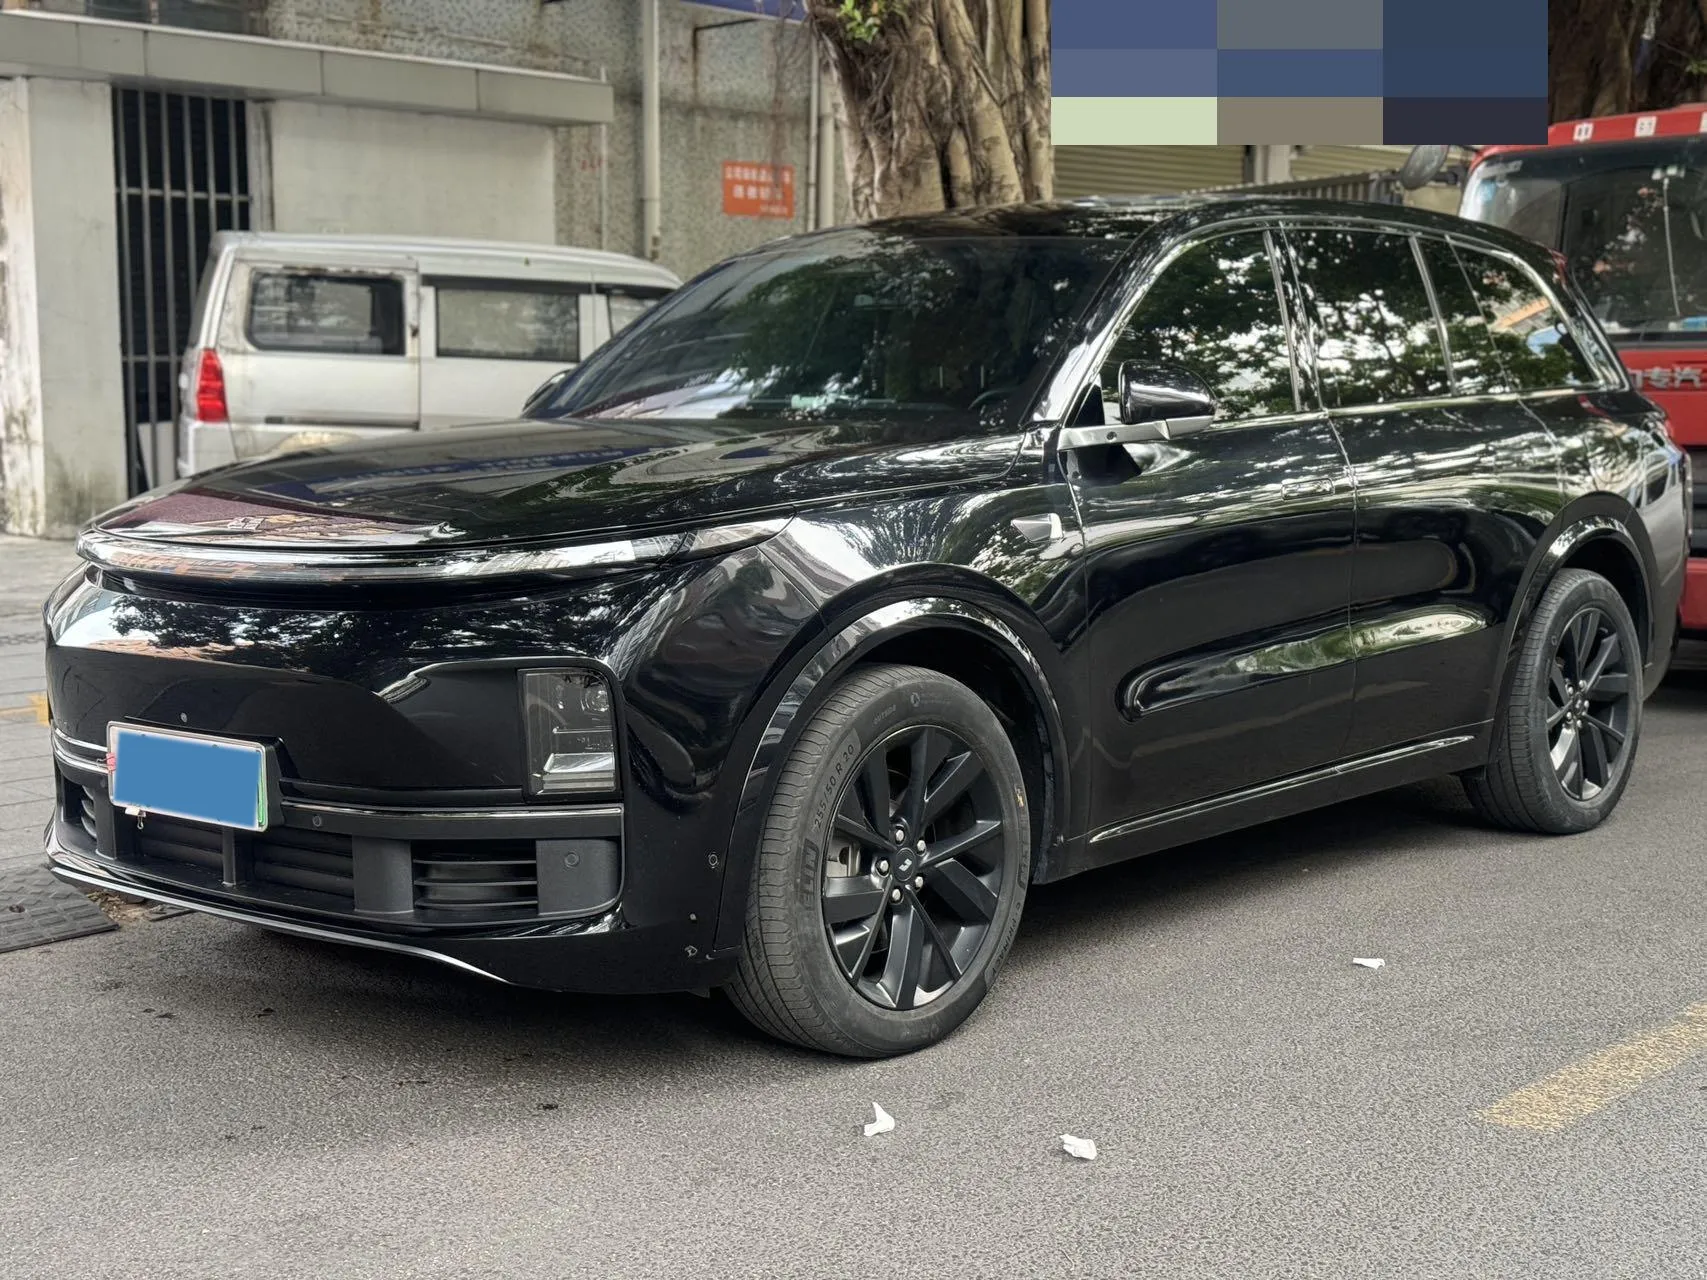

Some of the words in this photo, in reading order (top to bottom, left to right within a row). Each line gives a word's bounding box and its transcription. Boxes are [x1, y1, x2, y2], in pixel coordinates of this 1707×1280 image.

[814, 775, 837, 829] 255/50
[835, 763, 843, 775] R
[842, 744, 855, 762] 20
